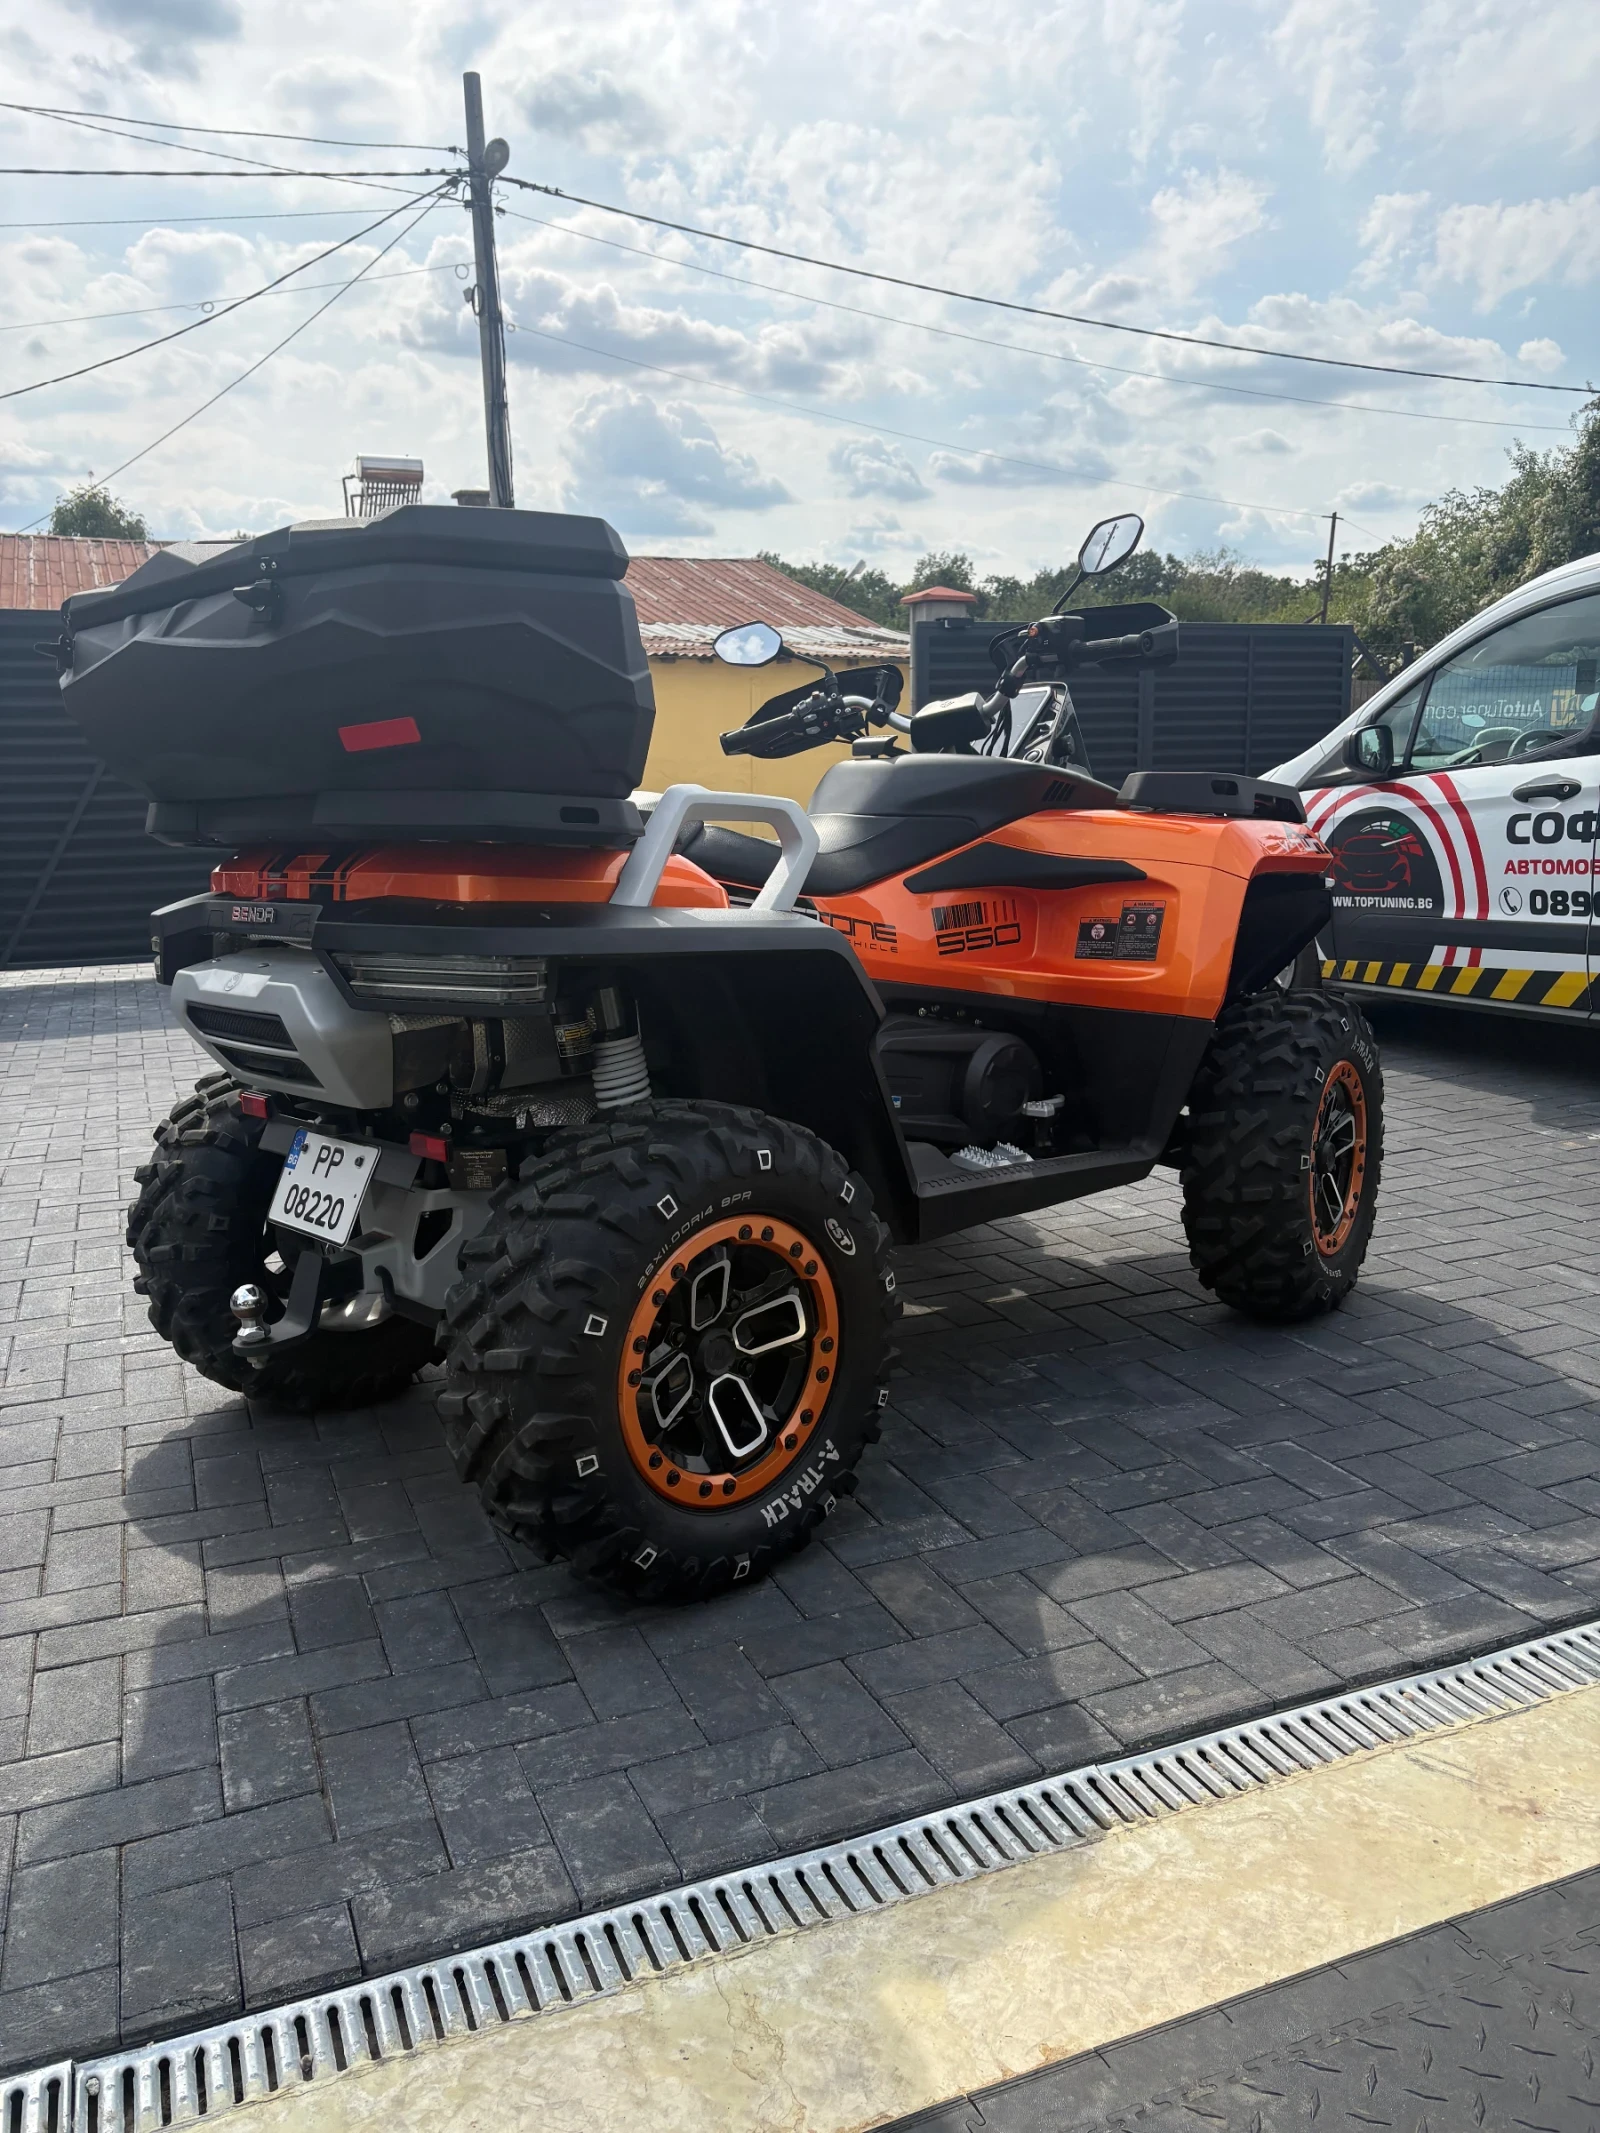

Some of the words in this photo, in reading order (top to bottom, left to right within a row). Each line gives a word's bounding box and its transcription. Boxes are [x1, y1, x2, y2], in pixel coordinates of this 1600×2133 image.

[232, 906, 275, 923] BENDA
[936, 922, 1021, 955] 550
[287, 1153, 299, 1165] BG
[312, 1144, 345, 1179] PP
[283, 1183, 345, 1231] 08220
[721, 1190, 752, 1208] 8PR
[827, 1218, 852, 1246] CST
[760, 1438, 840, 1528] A-TRACK
